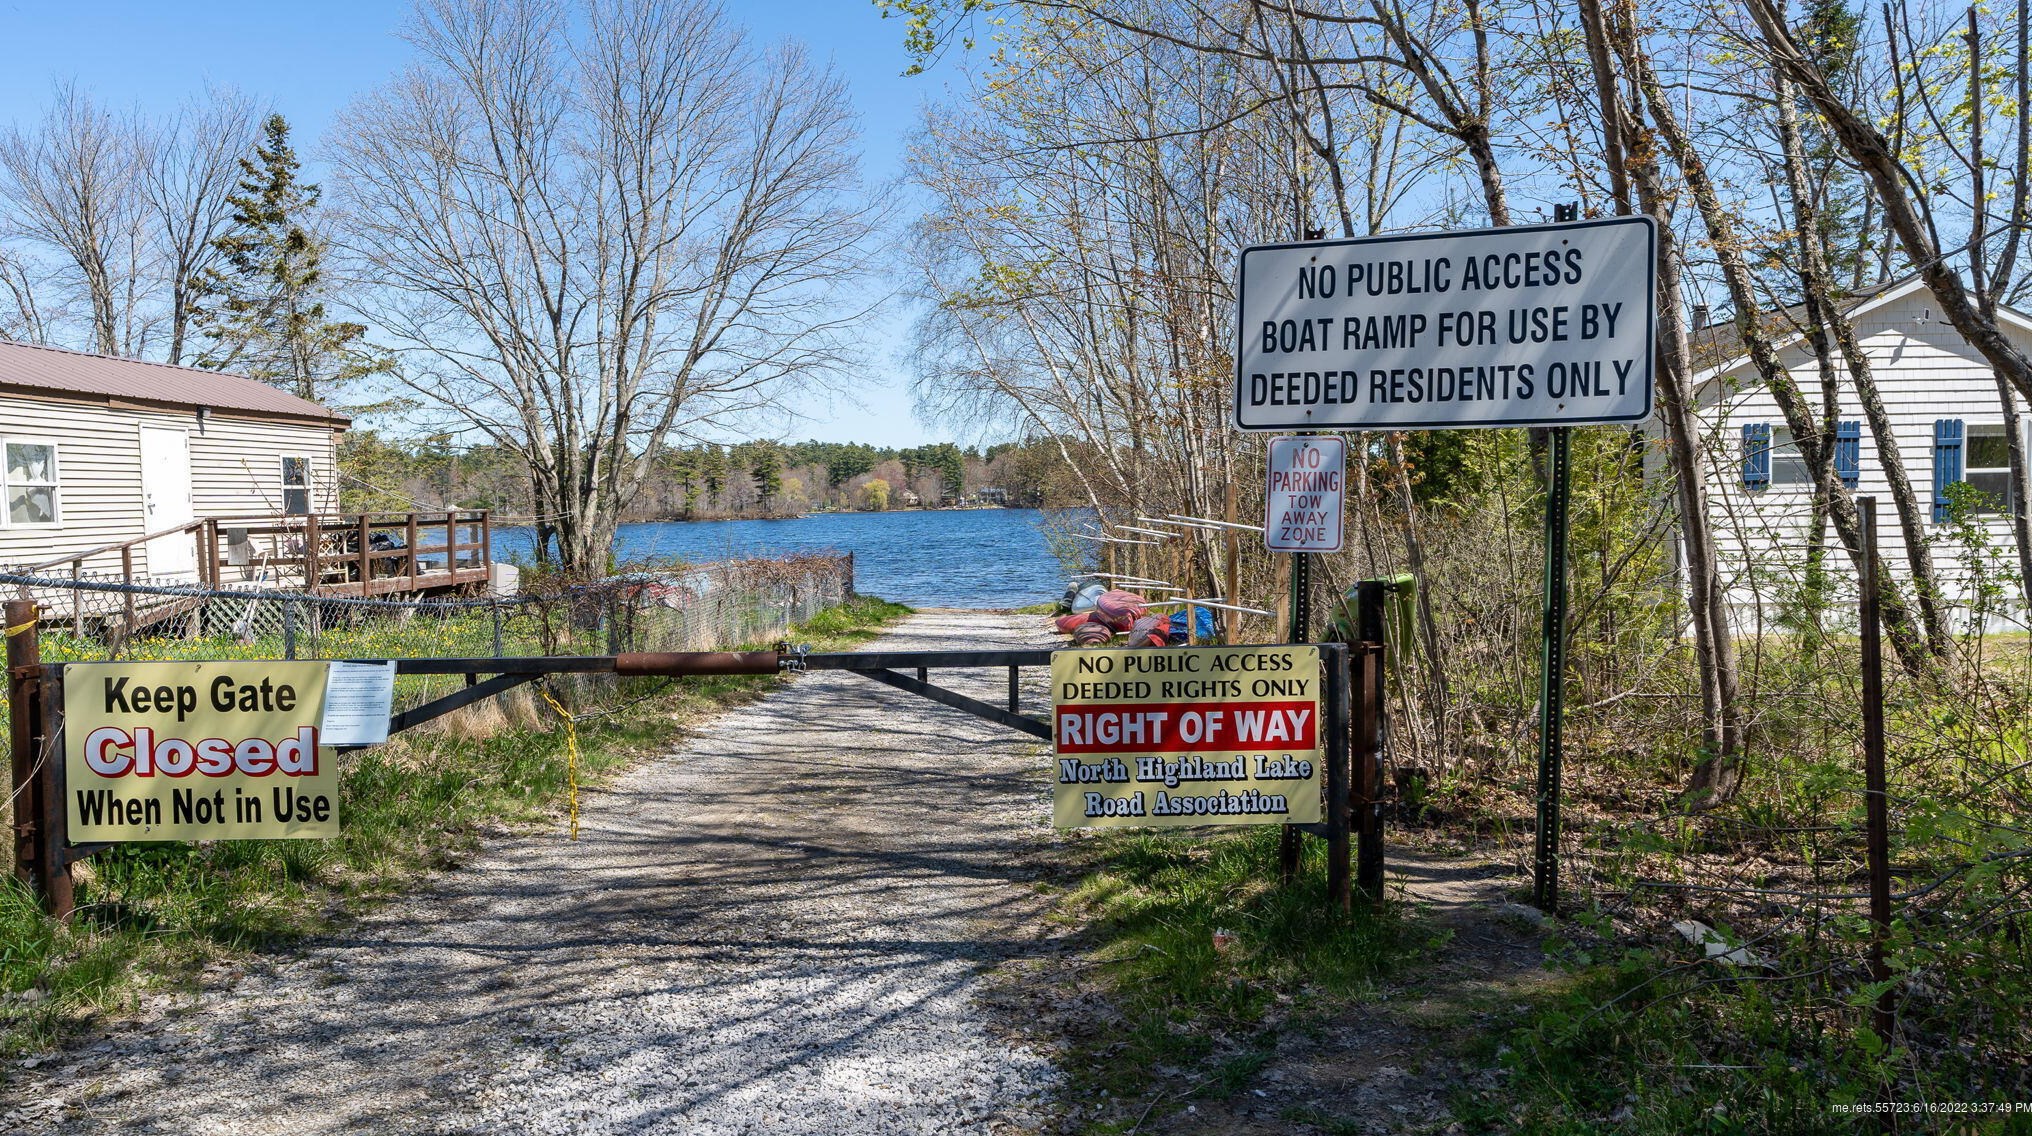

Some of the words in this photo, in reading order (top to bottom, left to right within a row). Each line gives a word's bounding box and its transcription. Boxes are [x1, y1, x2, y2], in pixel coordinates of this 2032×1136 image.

[1298, 265, 1336, 300] NO
[1347, 257, 1450, 297] PUBLIC
[1461, 249, 1582, 291] ACCESS
[1262, 318, 1333, 353] BOAT
[1343, 314, 1427, 350] RAMP
[1439, 310, 1496, 347] FOR
[1509, 306, 1568, 343] USE
[1581, 302, 1623, 340] BY
[1251, 371, 1358, 406] DEEDED
[1369, 364, 1534, 403] RESIDENTS
[1547, 360, 1633, 398] ONLY
[1293, 449, 1320, 469] NO
[1273, 472, 1338, 492] PARKING
[1288, 495, 1322, 509] TOW
[1281, 512, 1328, 525] AWAY
[1281, 528, 1326, 541] ZONE
[1078, 656, 1113, 673] NO
[1124, 655, 1200, 673] PUBLIC
[1210, 654, 1293, 672] ACCESS
[104, 677, 197, 722] Keep
[210, 676, 296, 712] Gate
[1063, 682, 1150, 699] DEEDED
[1162, 680, 1241, 698] RIGHTS
[1251, 679, 1309, 696] ONLY
[1061, 712, 1167, 745] RIGHT
[1180, 711, 1223, 743] OF
[1234, 710, 1311, 742] WAY
[84, 726, 319, 778] Closed
[1059, 758, 1129, 783] North
[1136, 756, 1248, 788] Highland
[1254, 755, 1312, 780] Lake
[77, 790, 161, 826] When
[173, 788, 225, 824] Not
[236, 788, 261, 823] in
[273, 787, 330, 822] Use
[1084, 792, 1146, 818] Road
[1152, 790, 1288, 816] Association
